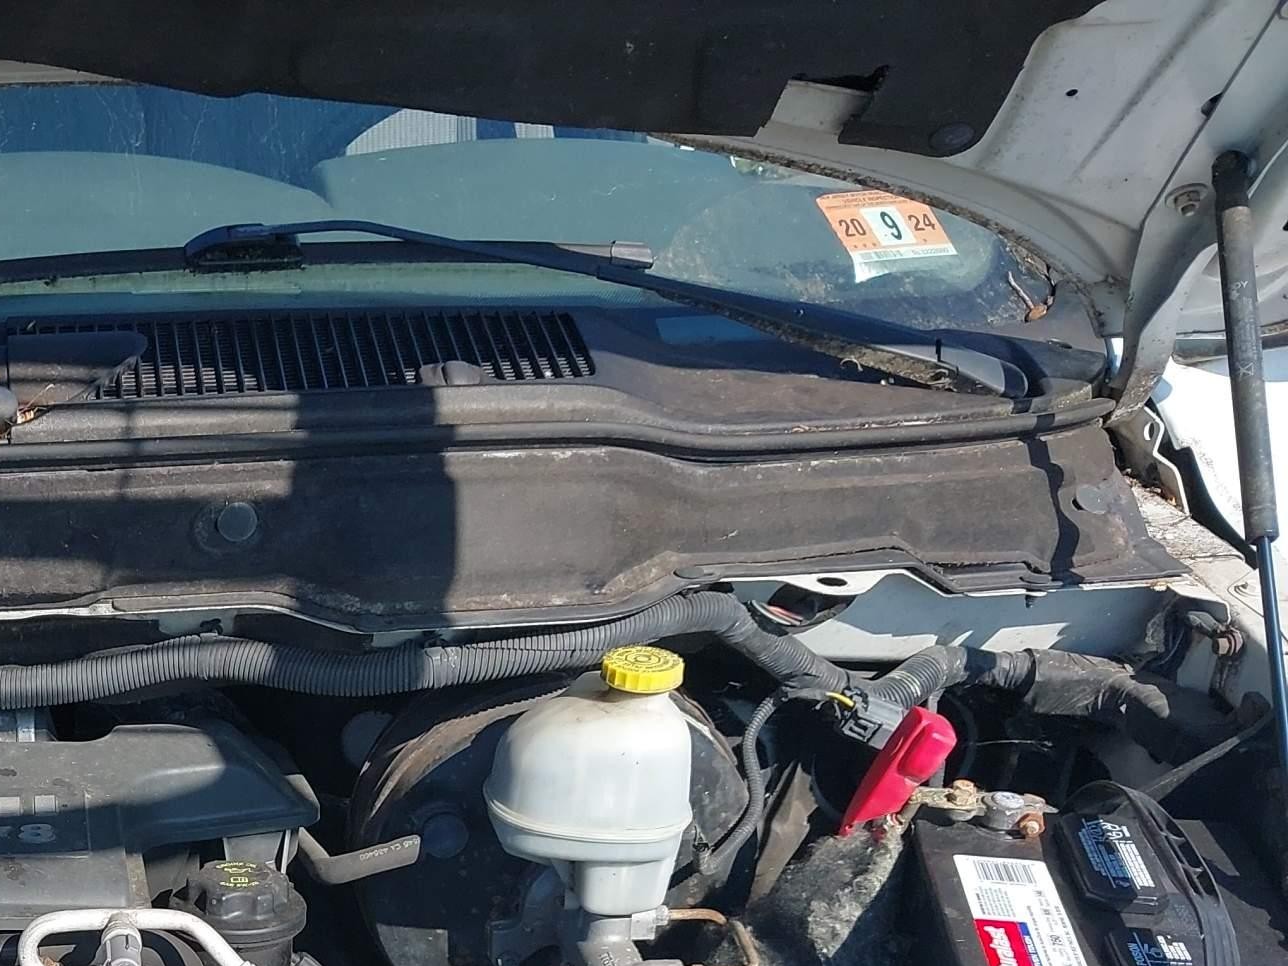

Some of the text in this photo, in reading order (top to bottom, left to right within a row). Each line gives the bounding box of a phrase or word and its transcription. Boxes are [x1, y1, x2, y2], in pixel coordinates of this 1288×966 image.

[839, 211, 936, 240] 20 9 24
